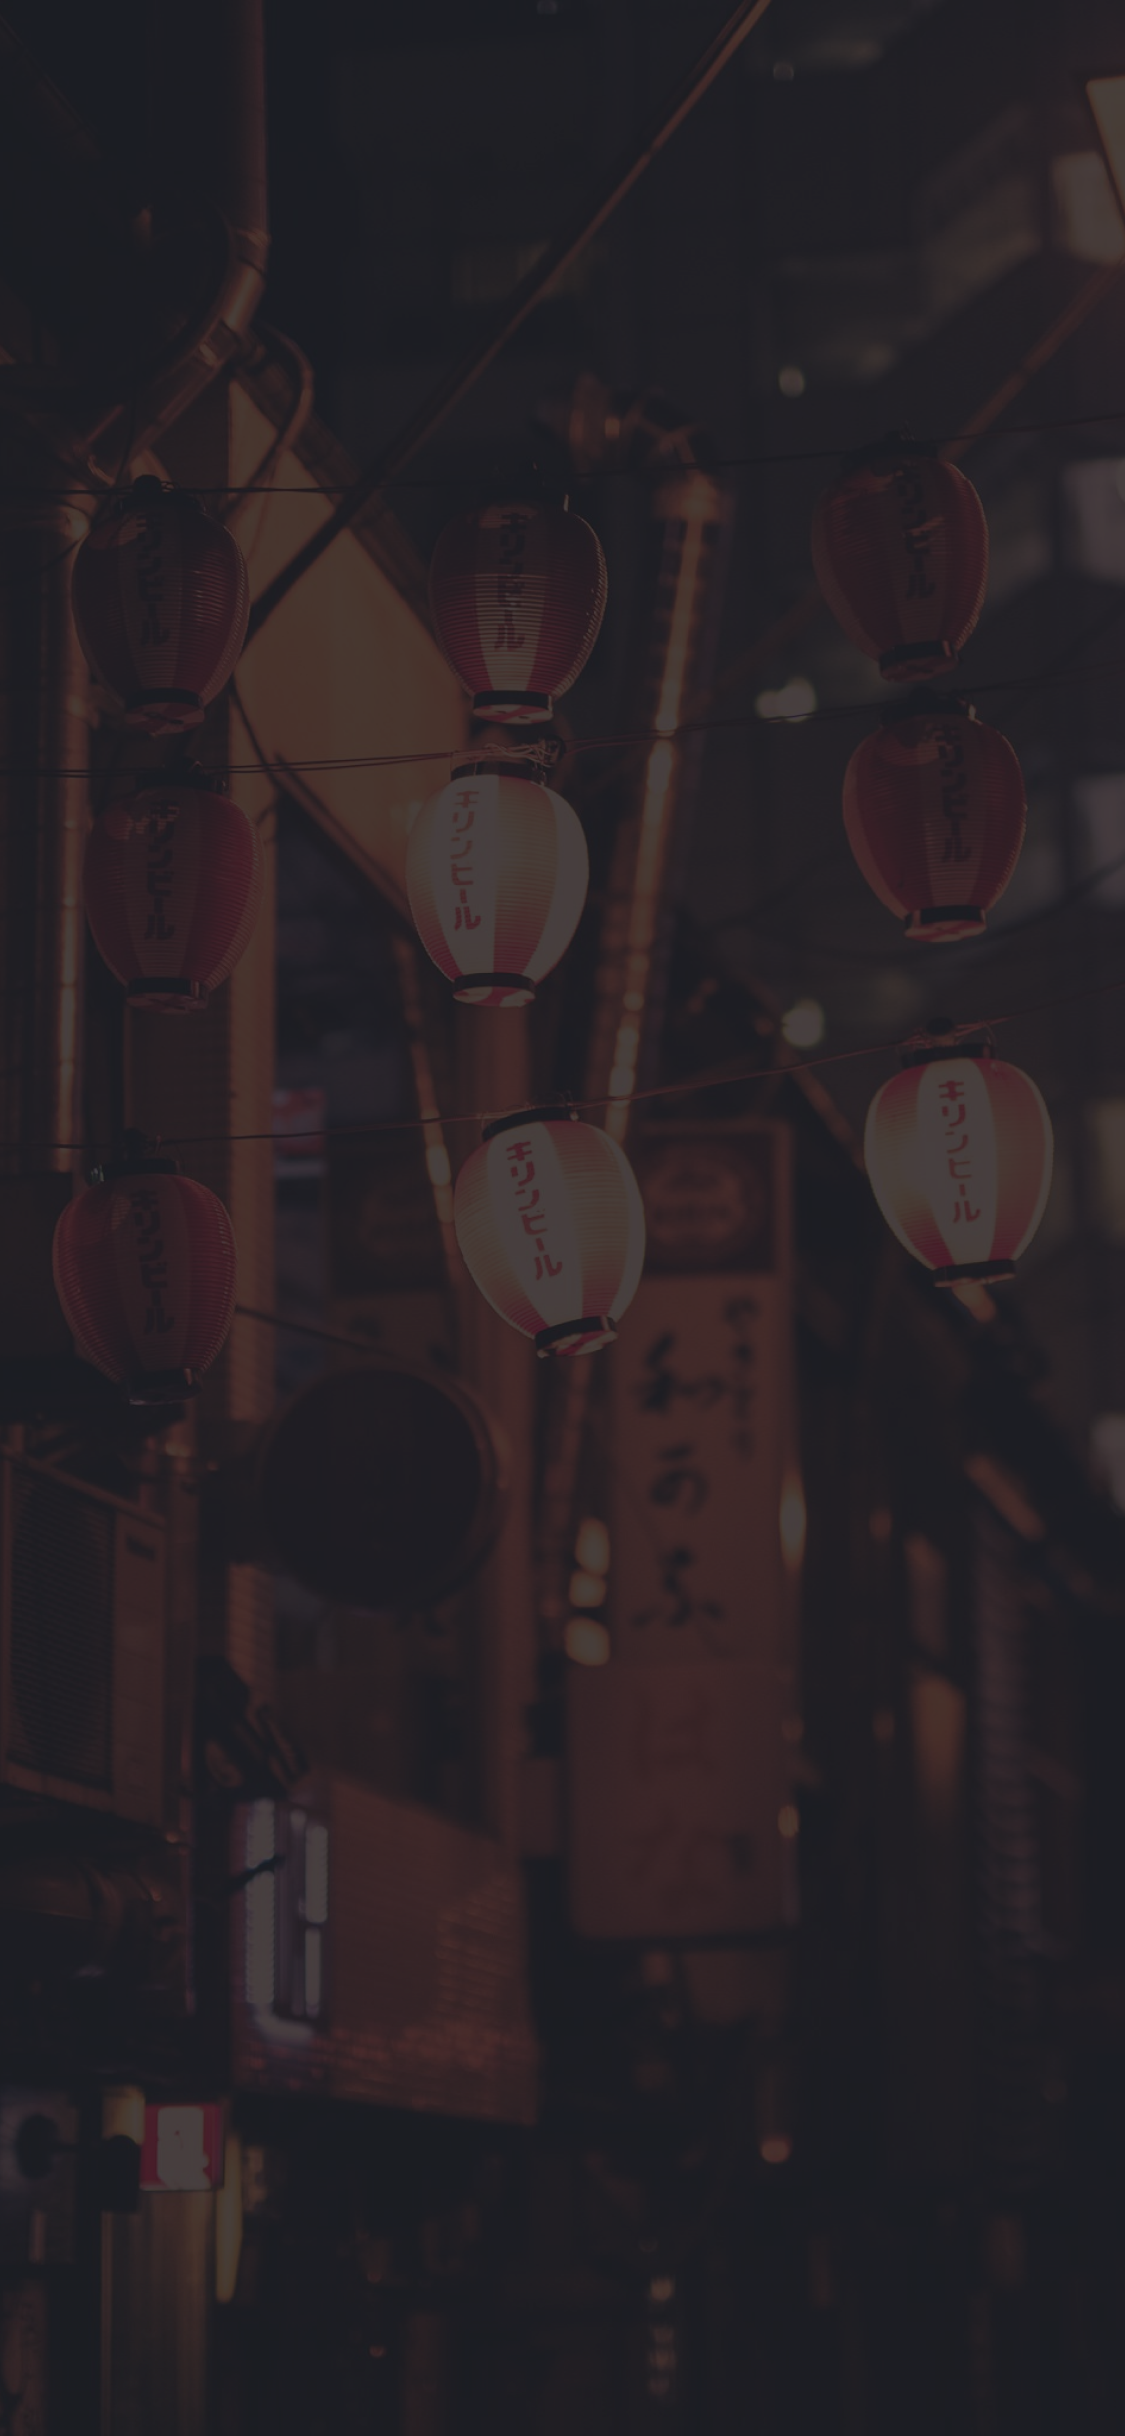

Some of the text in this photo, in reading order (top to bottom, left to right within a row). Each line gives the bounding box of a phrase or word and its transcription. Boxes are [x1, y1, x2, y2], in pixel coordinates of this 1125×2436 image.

[130, 1189, 175, 1335] キリンビール
[506, 1140, 562, 1281] キリンビール
